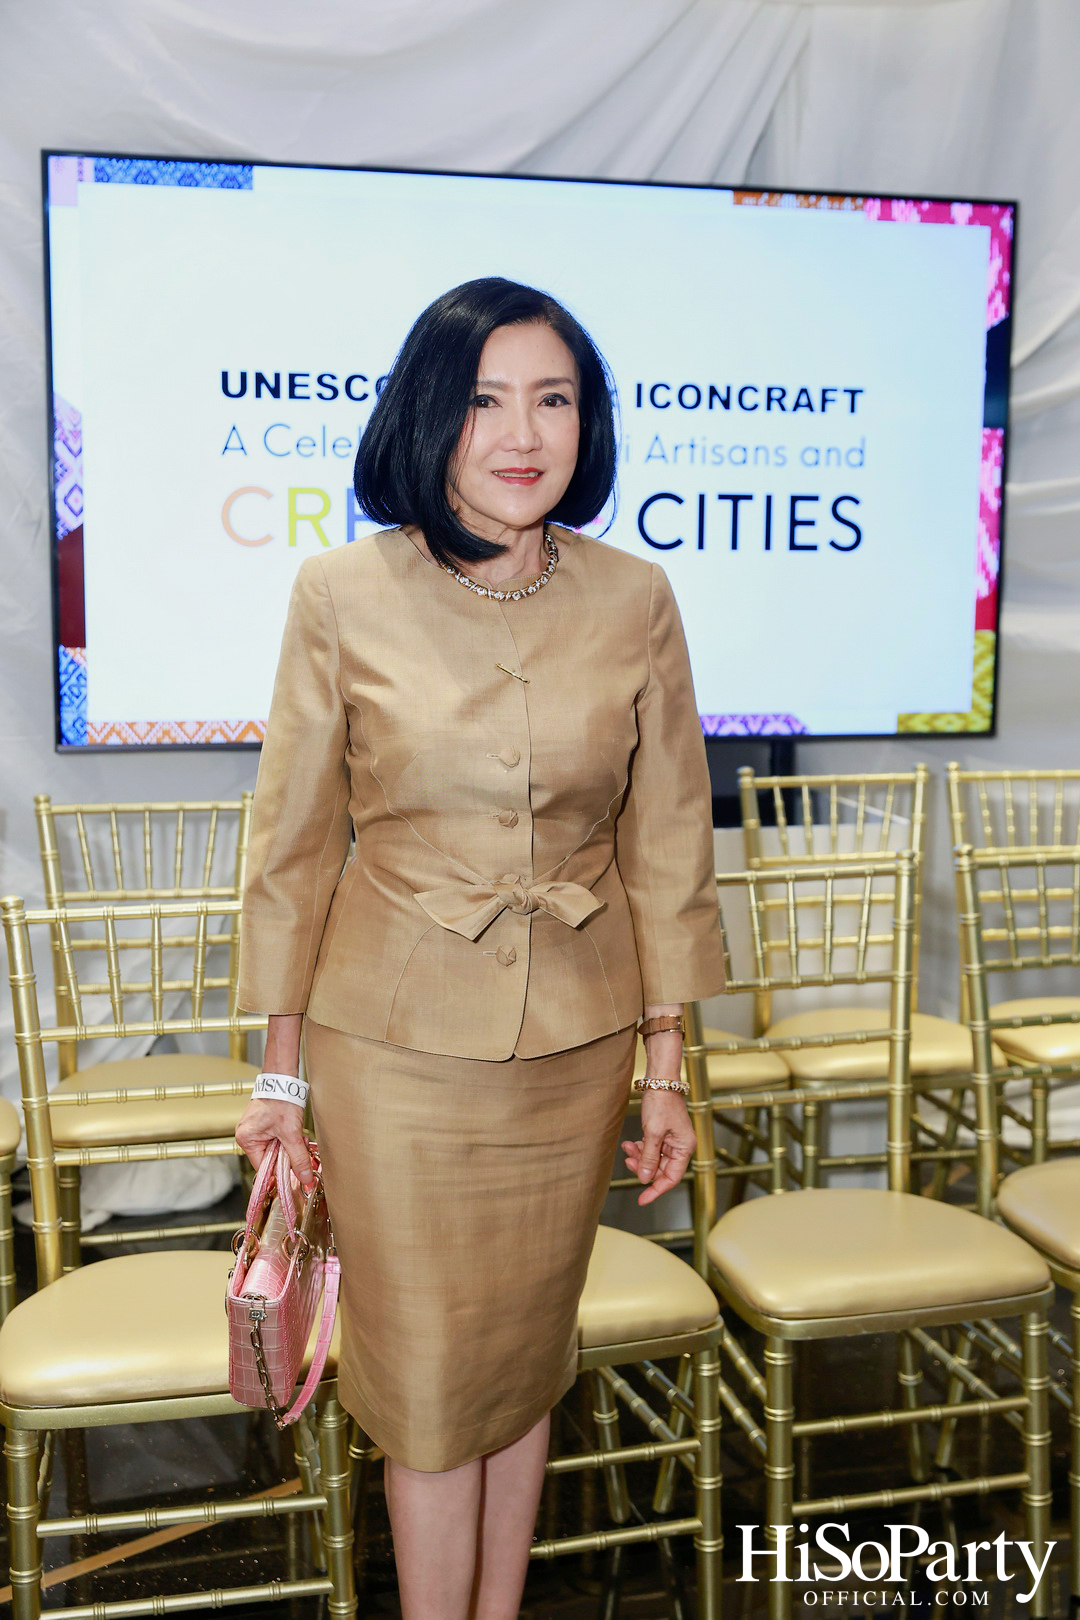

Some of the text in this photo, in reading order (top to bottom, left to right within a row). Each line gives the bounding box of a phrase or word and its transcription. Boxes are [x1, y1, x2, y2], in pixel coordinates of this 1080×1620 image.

[636, 383, 864, 413] ICONCRAFT
[222, 424, 247, 456] A
[644, 433, 788, 466] Artisans
[800, 436, 866, 467] and
[637, 492, 862, 552] CITIES
